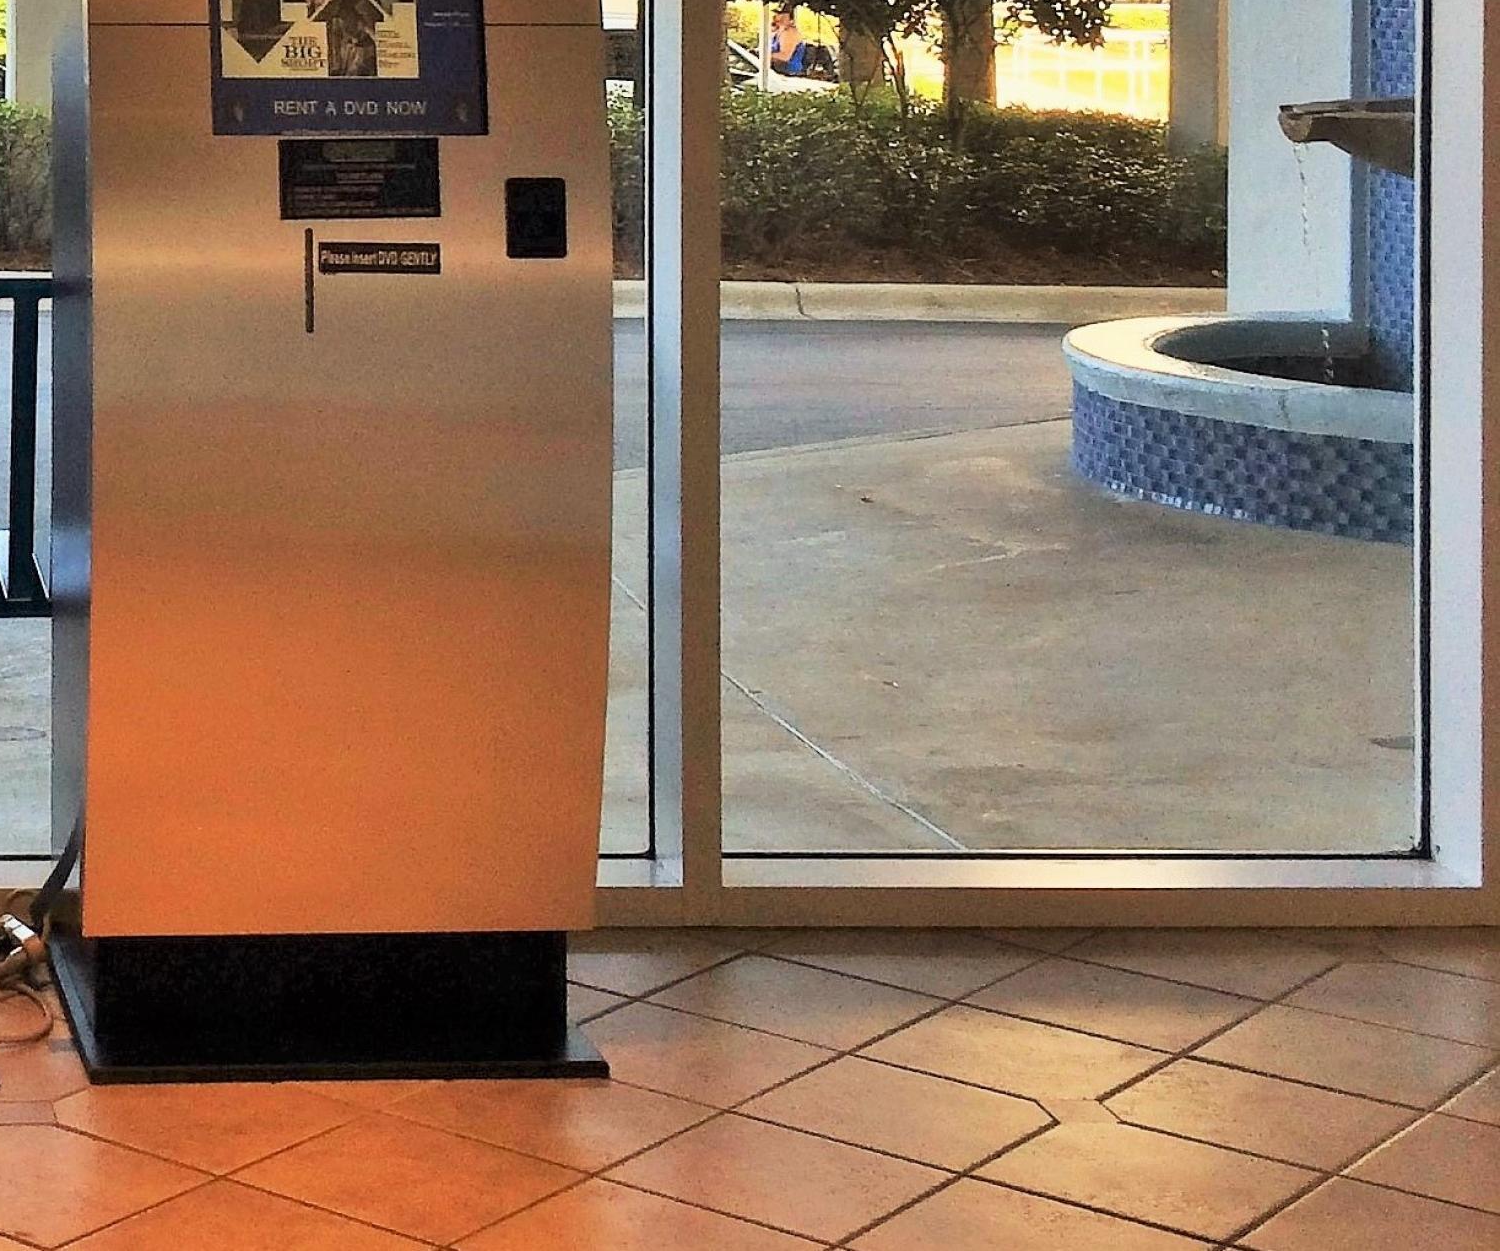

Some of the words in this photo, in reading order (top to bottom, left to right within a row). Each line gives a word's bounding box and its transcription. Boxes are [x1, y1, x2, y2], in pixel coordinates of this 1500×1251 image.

[283, 45, 322, 60] BIG
[274, 100, 317, 115] RENT
[325, 101, 337, 115] A
[344, 101, 379, 115] DVD
[387, 101, 427, 115] NOW
[320, 249, 350, 265] Please
[378, 250, 398, 266] DVD
[400, 250, 438, 267] GENTLY
